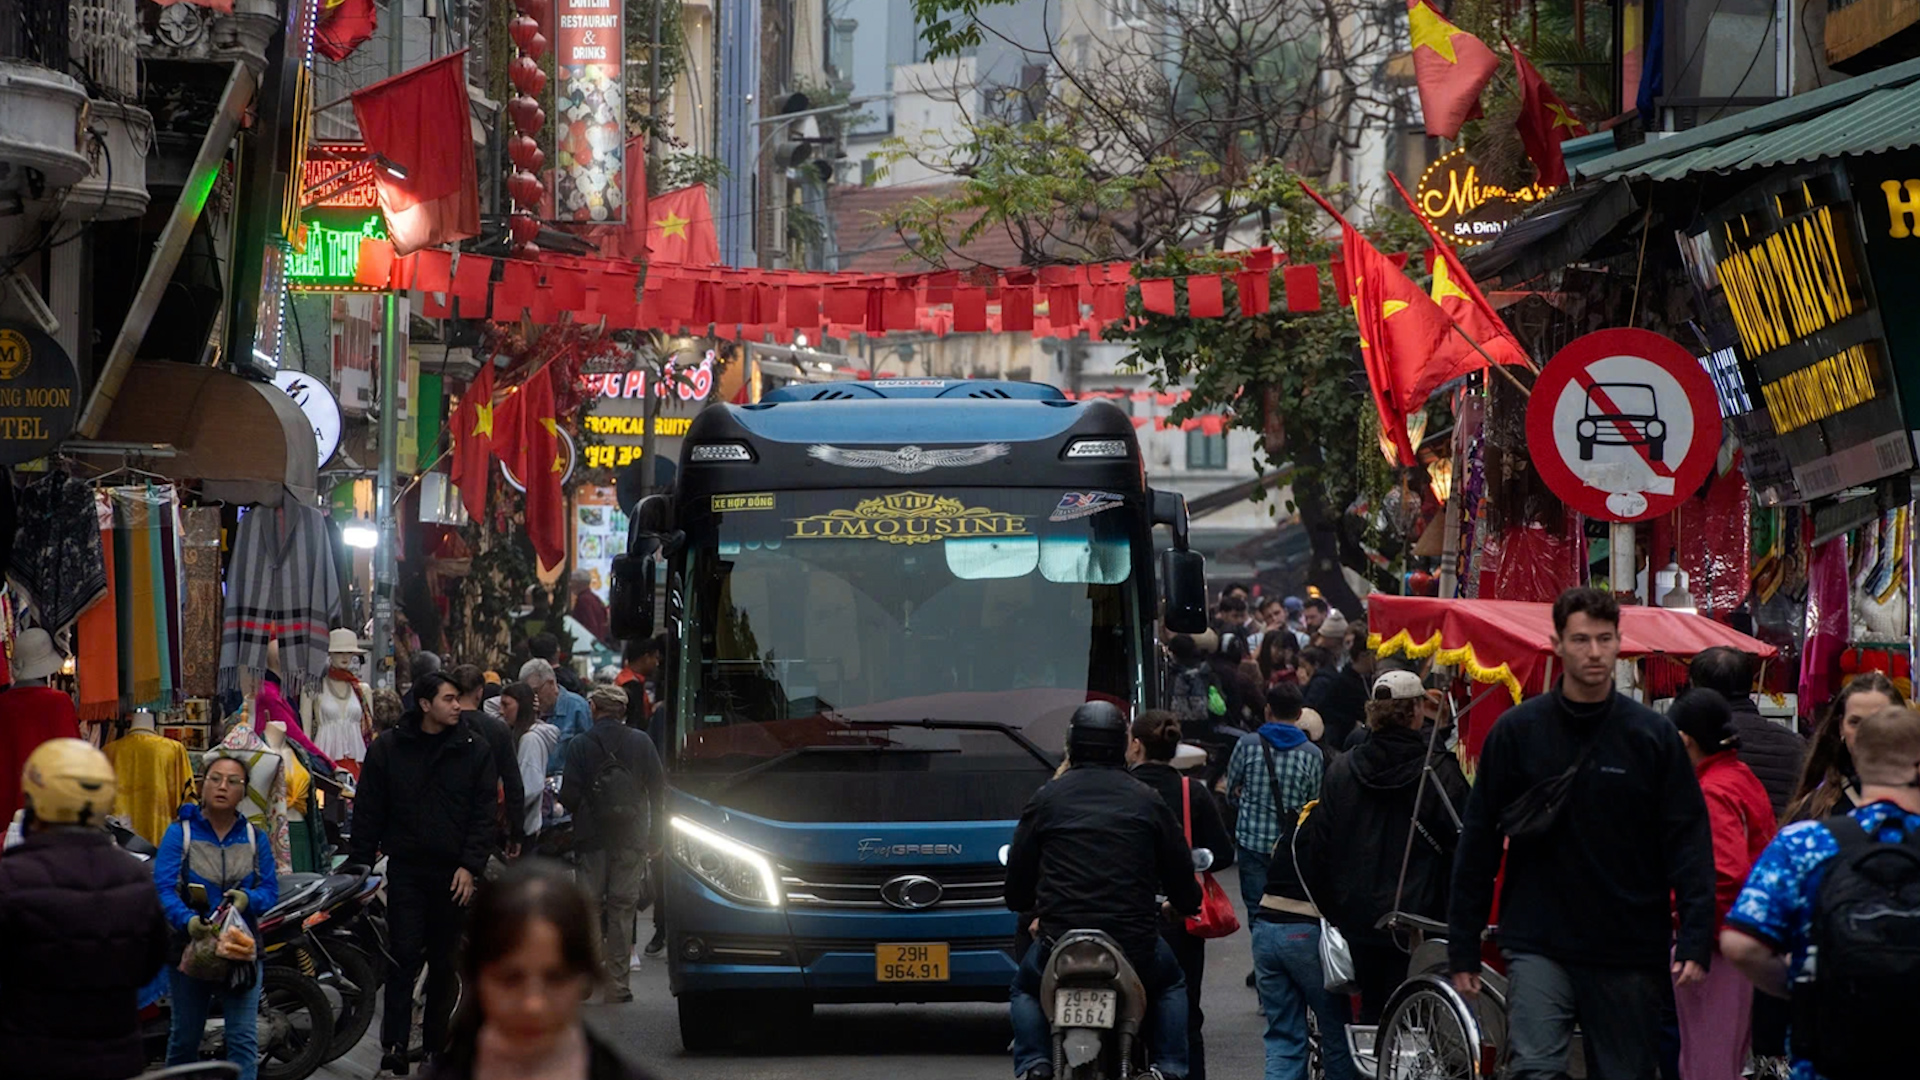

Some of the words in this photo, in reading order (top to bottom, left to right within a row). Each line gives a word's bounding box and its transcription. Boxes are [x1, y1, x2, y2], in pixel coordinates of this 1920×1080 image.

[560, 15, 618, 28] RESTAURANT
[582, 30, 596, 45] &
[572, 46, 606, 60] DRINKS
[1454, 222, 1471, 235] 5A
[25, 388, 71, 408] MOON
[654, 417, 692, 435] RUITS
[714, 499, 726, 509] XE
[893, 496, 927, 508] VIP
[794, 517, 1027, 537] LIMOUSINE
[897, 946, 928, 962] 29H
[884, 964, 940, 979] 964.91
[1063, 1008, 1105, 1024] 6664
